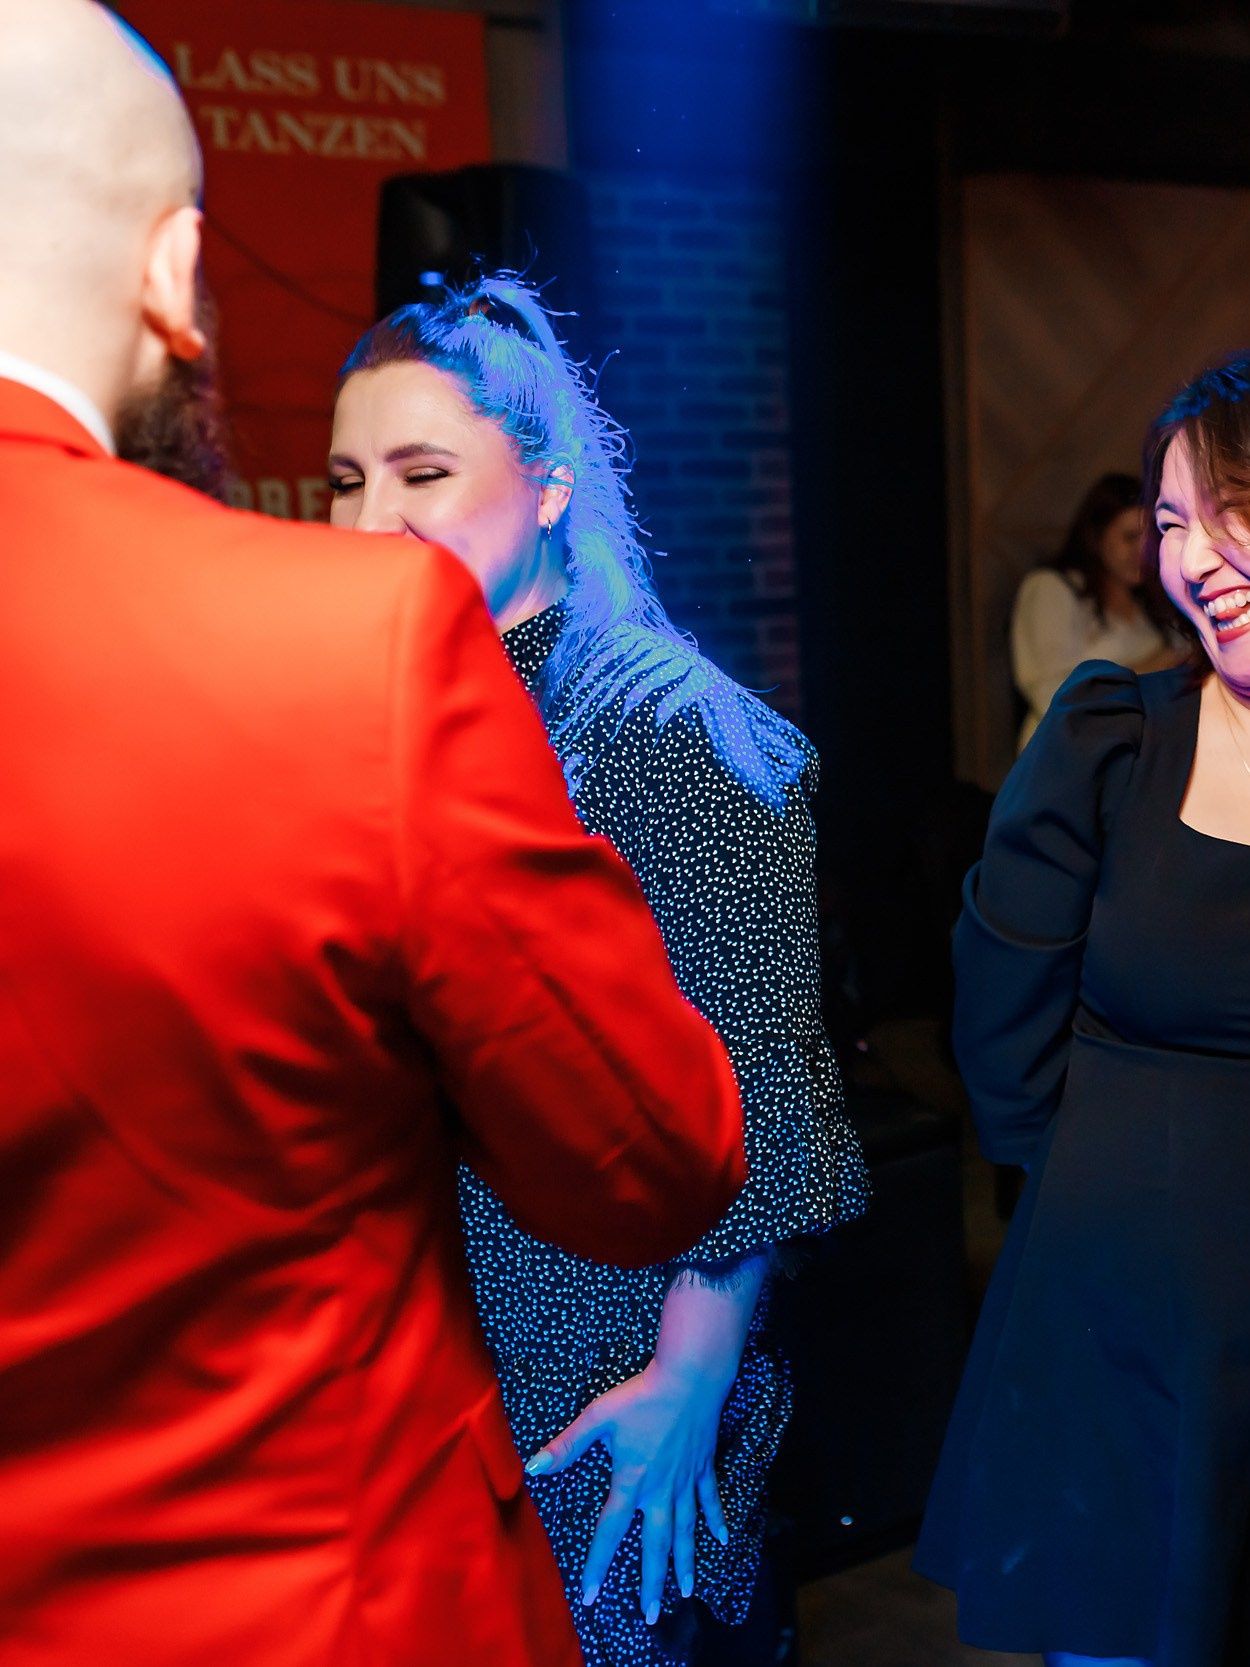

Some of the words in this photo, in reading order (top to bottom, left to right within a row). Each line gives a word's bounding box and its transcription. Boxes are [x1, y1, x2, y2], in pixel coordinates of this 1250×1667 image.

[173, 42, 319, 97] LASS
[332, 54, 446, 108] UNS
[198, 104, 427, 161] TANZEN
